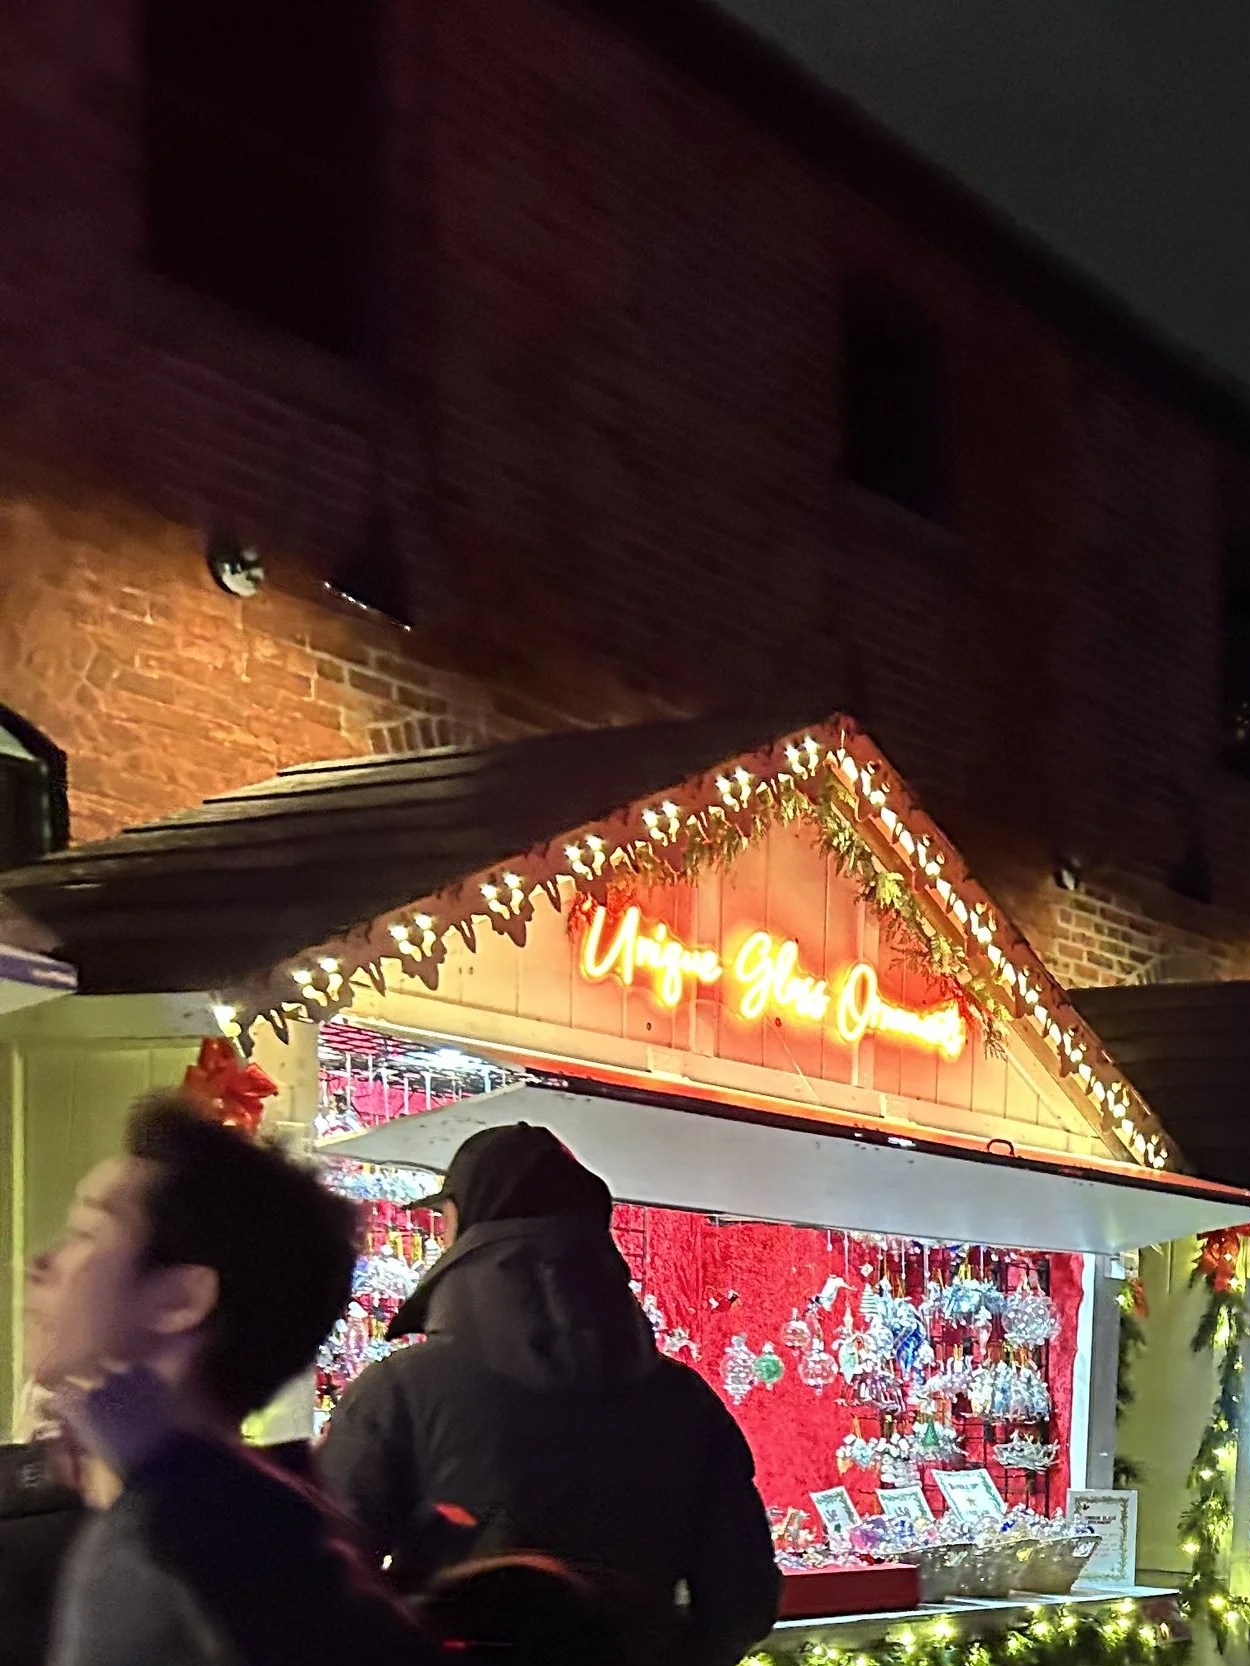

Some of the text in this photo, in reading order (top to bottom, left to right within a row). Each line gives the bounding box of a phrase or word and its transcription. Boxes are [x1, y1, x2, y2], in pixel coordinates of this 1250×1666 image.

[586, 906, 965, 1055] Unique Glass Ornts
